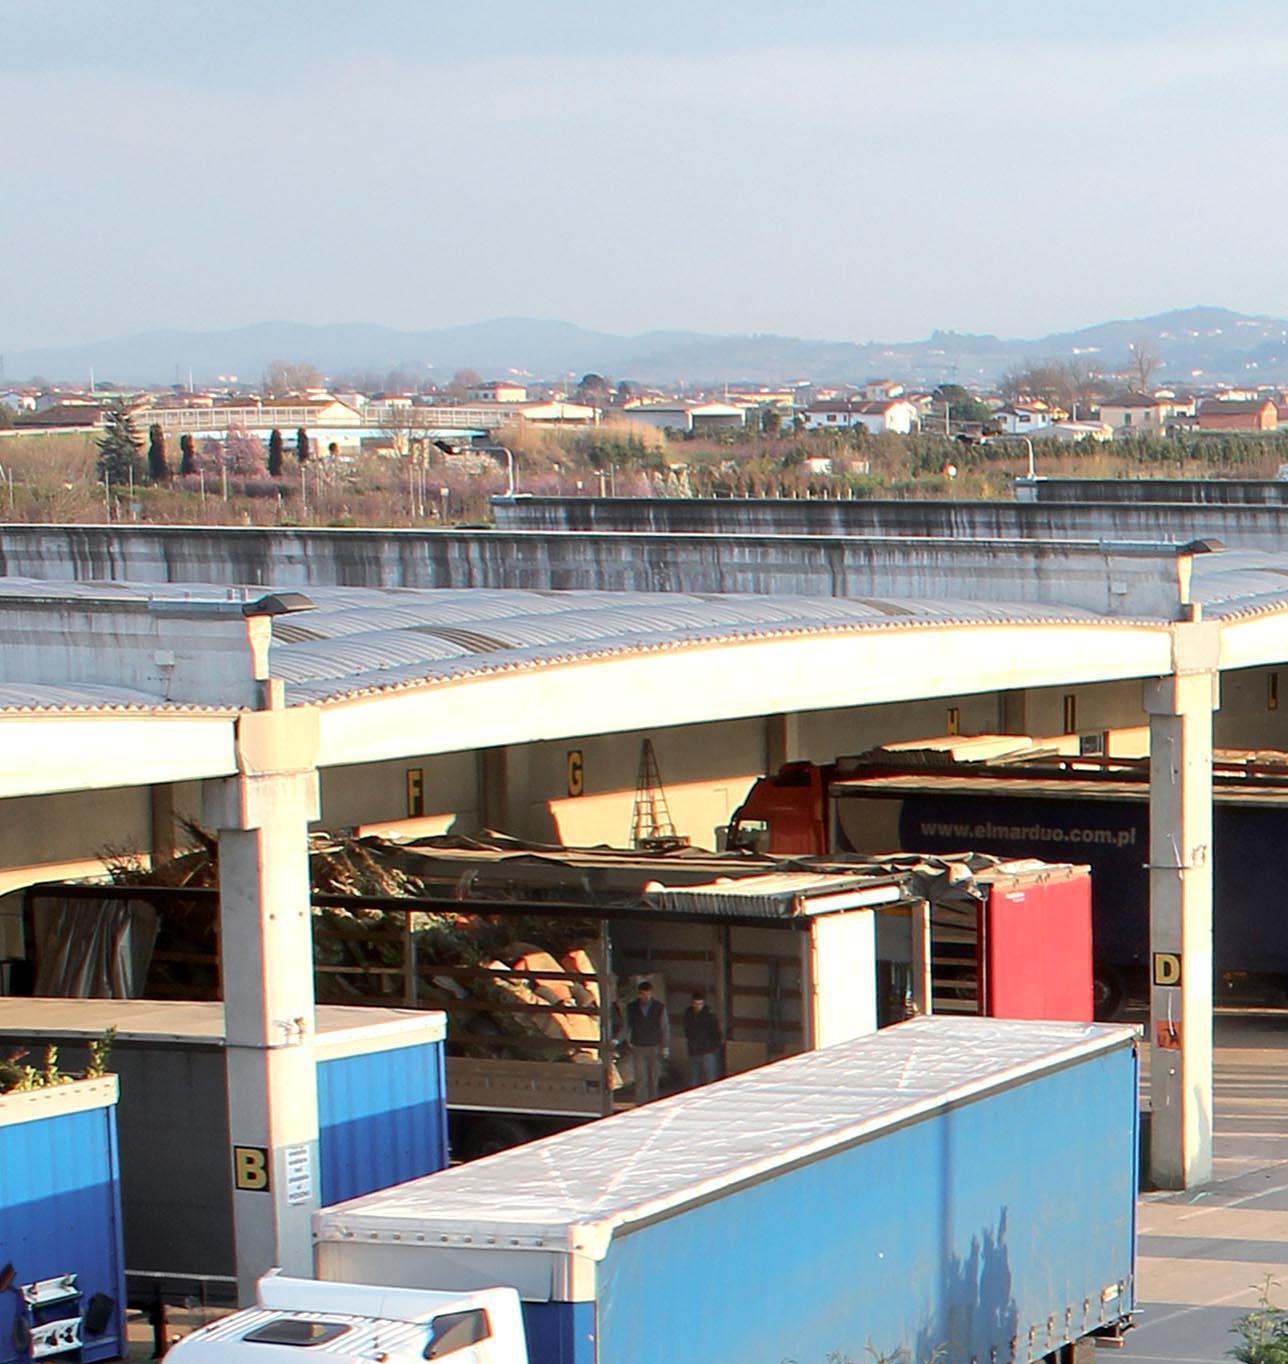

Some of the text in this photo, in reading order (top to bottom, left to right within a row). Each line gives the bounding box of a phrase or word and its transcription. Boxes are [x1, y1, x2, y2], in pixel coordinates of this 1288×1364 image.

[407, 769, 421, 815] F
[568, 751, 583, 796] G
[921, 822, 1137, 847] www.elmarduo.com.pl
[1154, 953, 1180, 985] D
[235, 1147, 268, 1190] B
